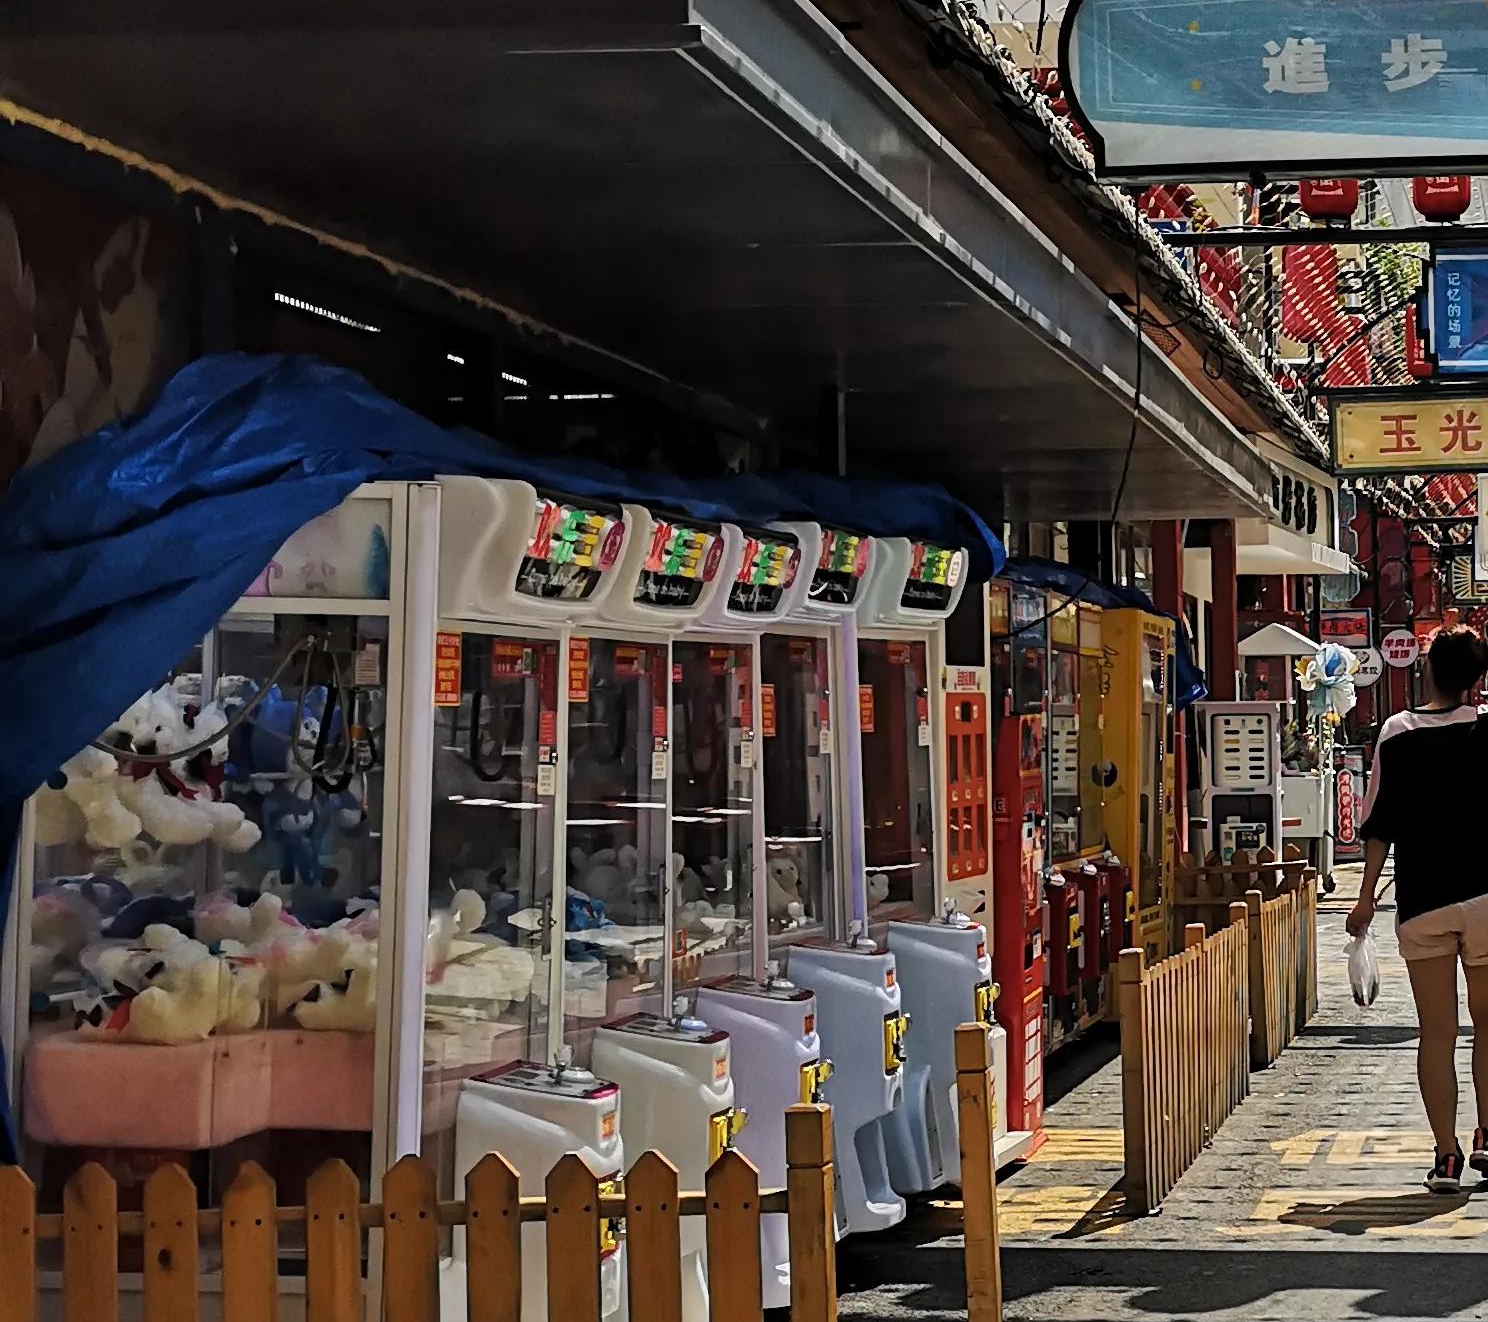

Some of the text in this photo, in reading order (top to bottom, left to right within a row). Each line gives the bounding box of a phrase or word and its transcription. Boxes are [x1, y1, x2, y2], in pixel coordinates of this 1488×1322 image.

[1446, 272, 1463, 350] 记忆的场景
